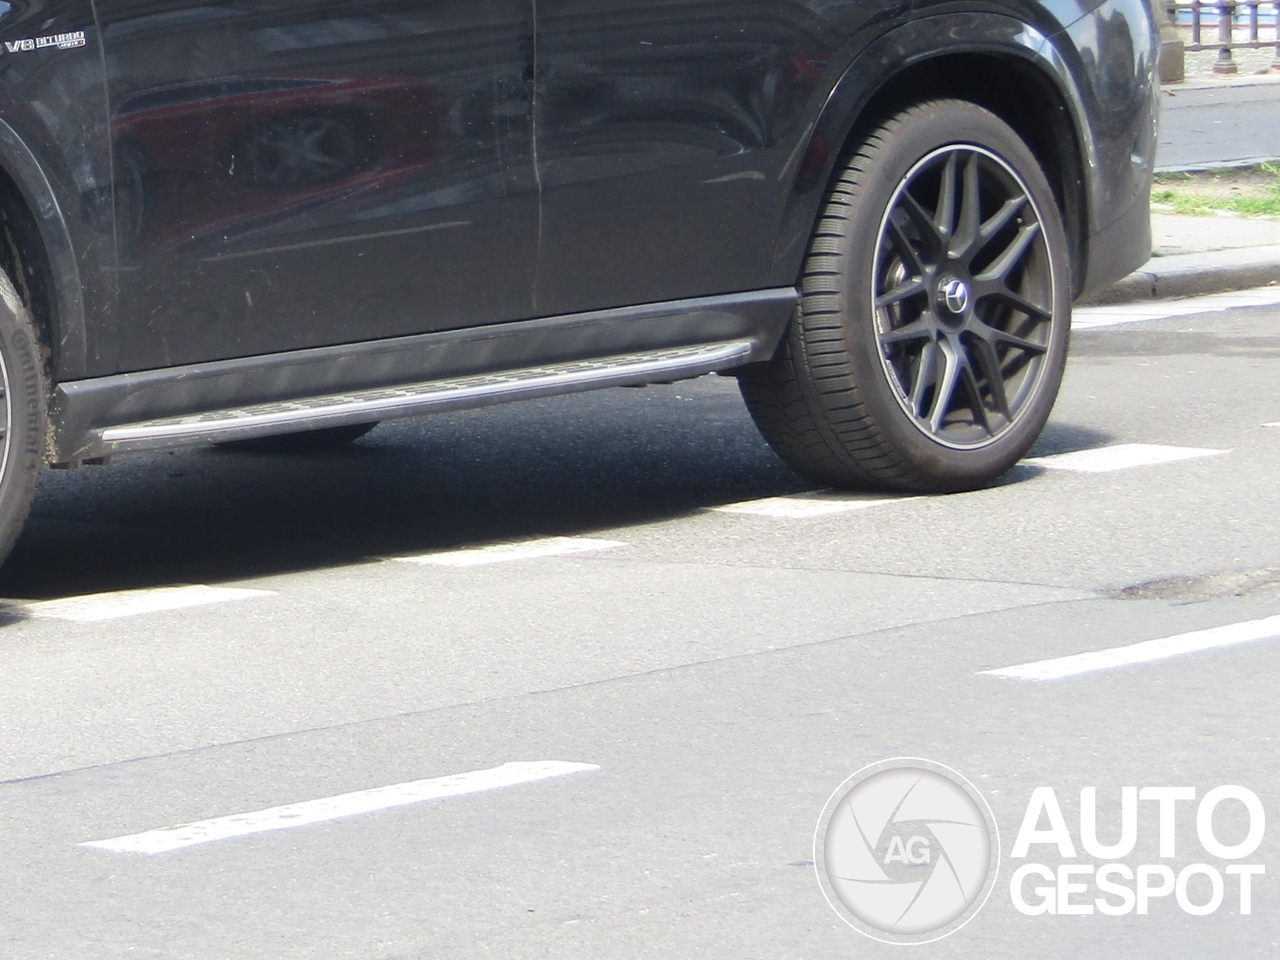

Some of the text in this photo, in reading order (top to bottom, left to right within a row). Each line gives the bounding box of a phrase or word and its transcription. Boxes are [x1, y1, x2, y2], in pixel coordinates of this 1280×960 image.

[4, 38, 35, 53] V8
[36, 31, 85, 45] BITURBO
[11, 329, 39, 454] Continental
